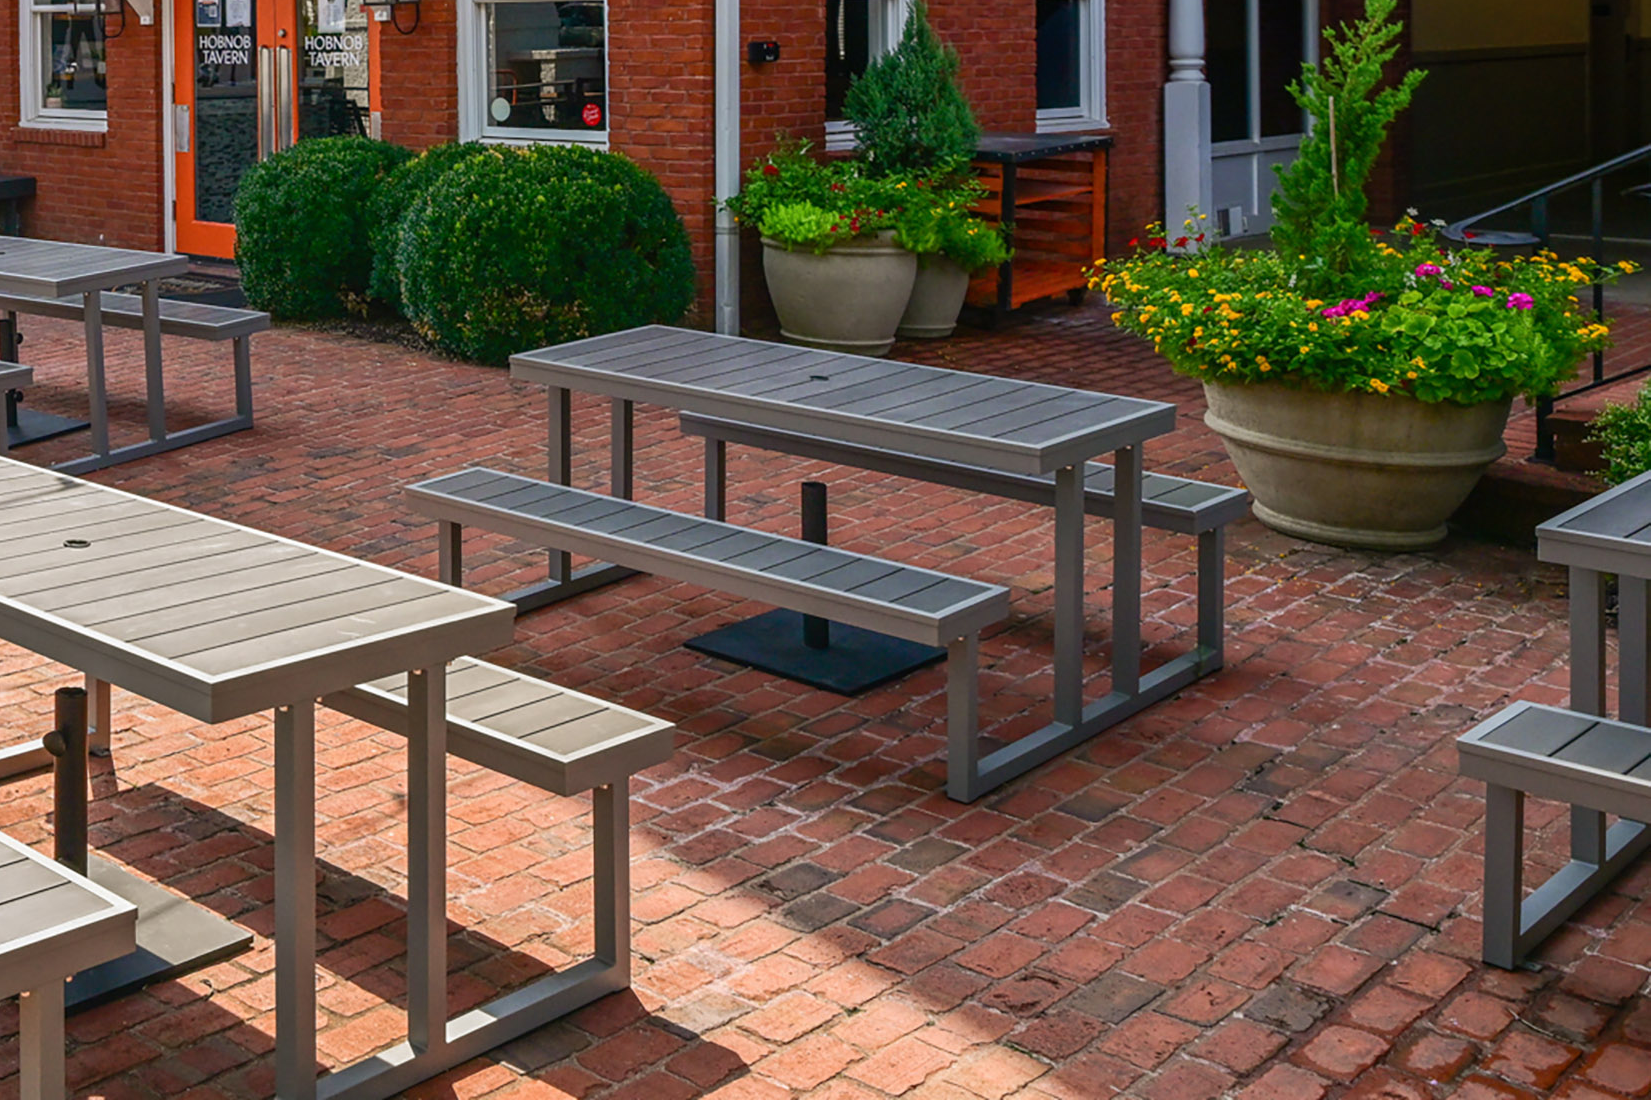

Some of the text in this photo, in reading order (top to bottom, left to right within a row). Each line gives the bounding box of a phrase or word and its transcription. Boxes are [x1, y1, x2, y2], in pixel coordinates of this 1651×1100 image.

[200, 35, 251, 50] HOBNOB
[305, 35, 363, 50] HOBNOB
[203, 51, 249, 65] TAVERN
[309, 51, 360, 67] TAVERN
